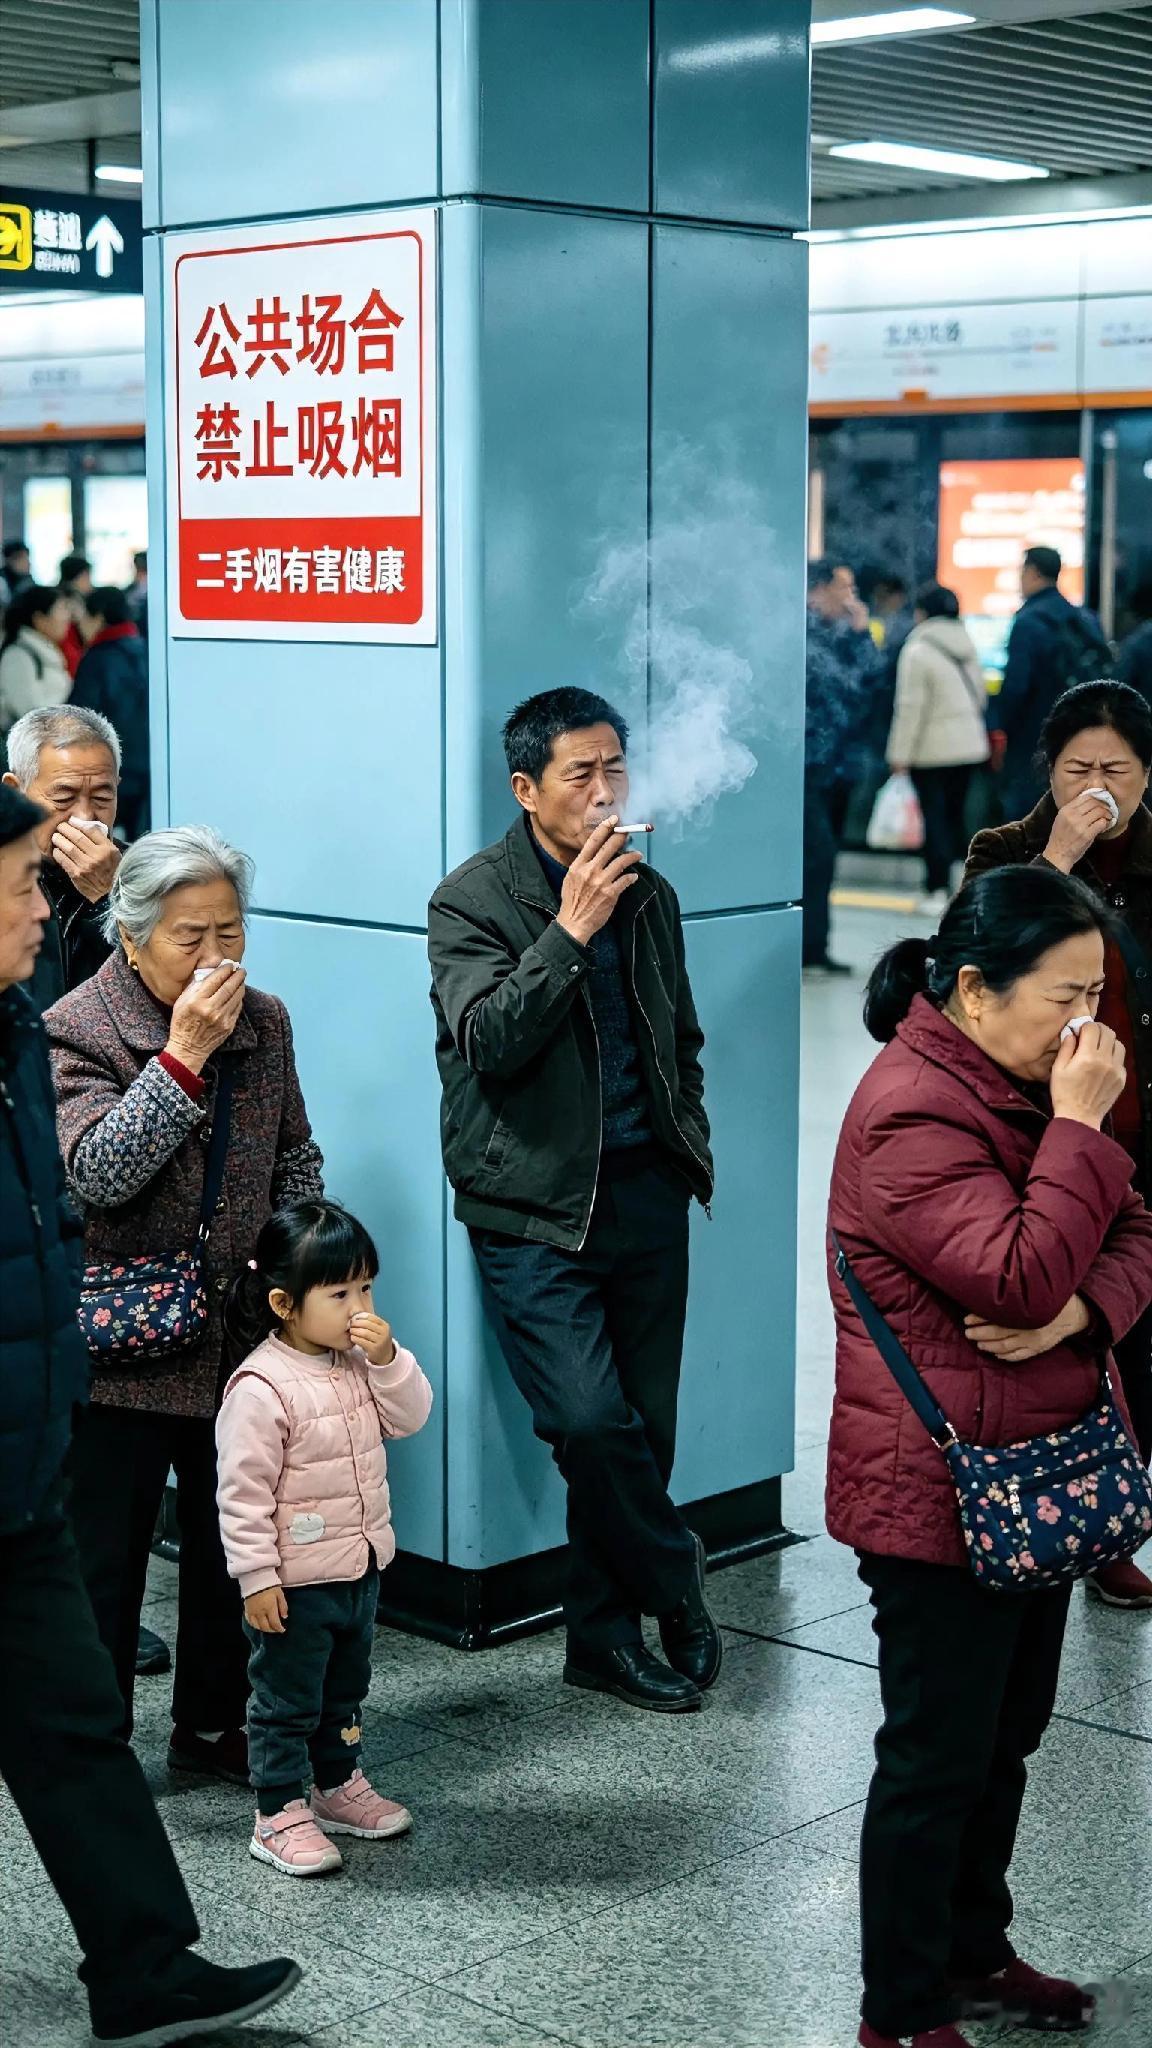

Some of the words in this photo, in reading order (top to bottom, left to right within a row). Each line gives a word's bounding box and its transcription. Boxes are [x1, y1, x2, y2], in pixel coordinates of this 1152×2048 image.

[194, 288, 404, 380] 公共场合
[194, 397, 402, 482] 禁止吸烟
[196, 545, 405, 594] 二手烟有害健康
